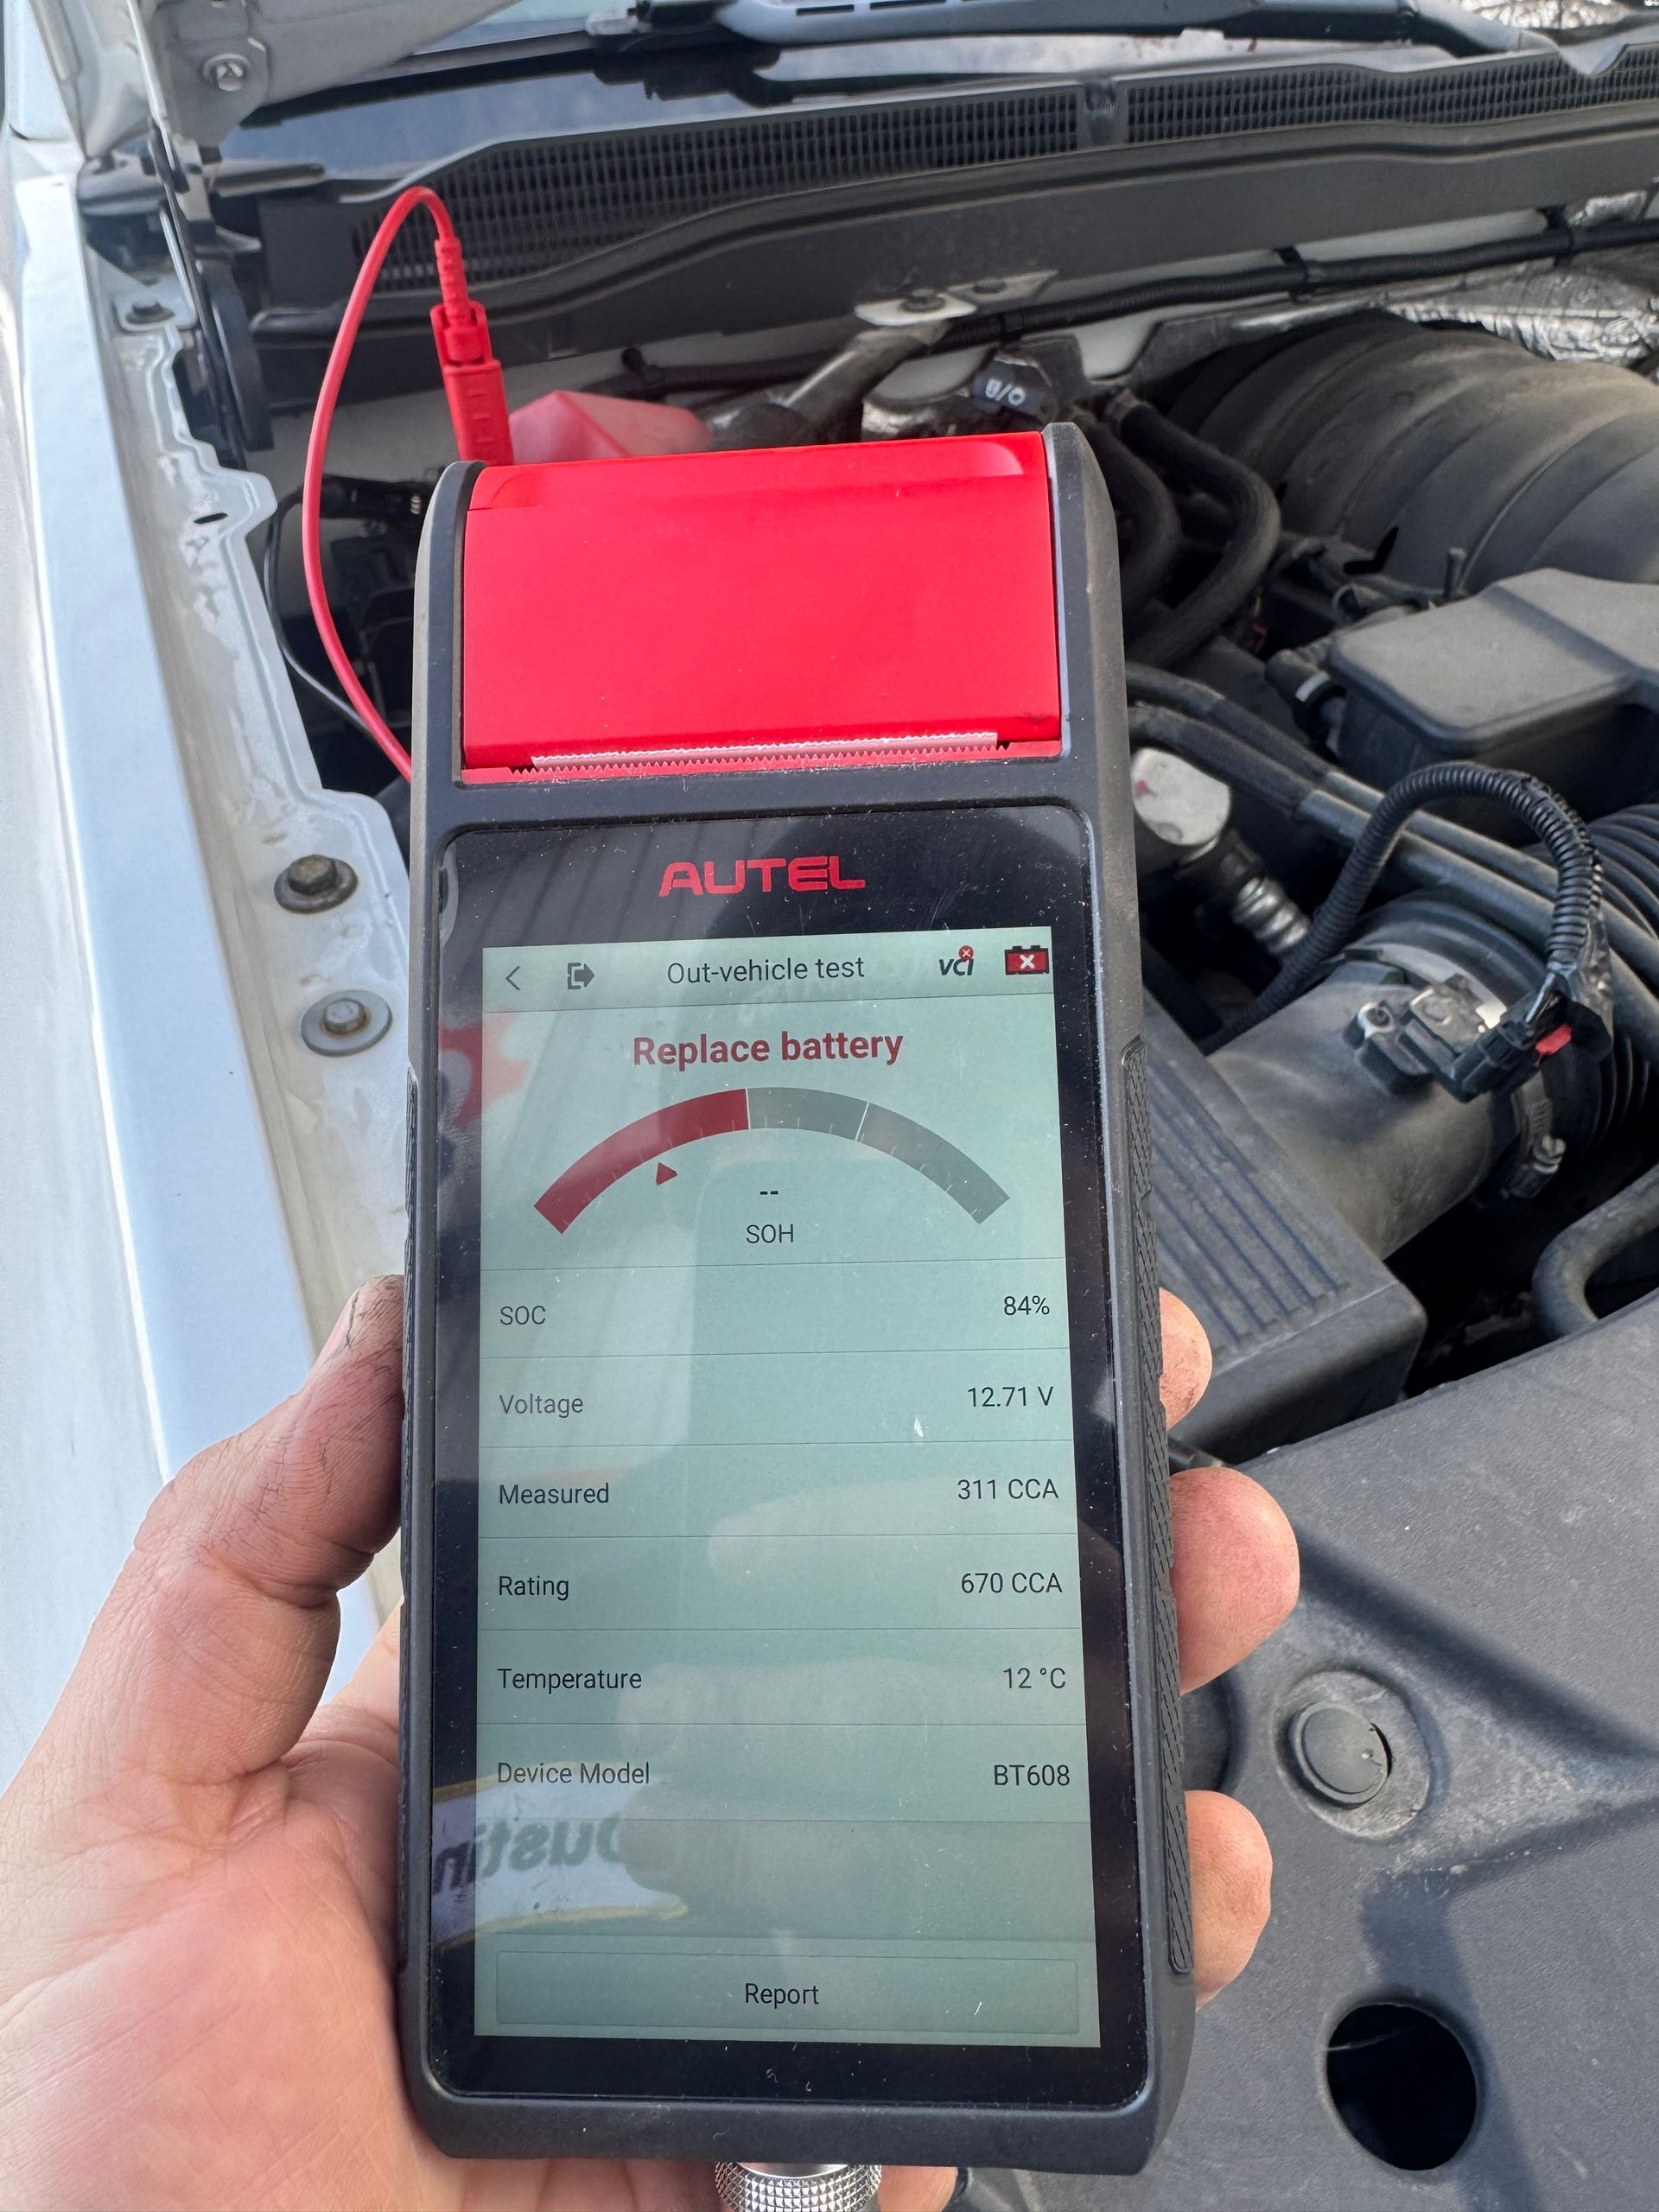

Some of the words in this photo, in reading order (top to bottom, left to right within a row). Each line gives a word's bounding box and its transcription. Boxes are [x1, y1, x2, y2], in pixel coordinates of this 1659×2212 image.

[659, 855, 866, 897] AUTEL
[667, 958, 808, 985] Out-vehicle
[816, 957, 865, 980] test
[633, 1033, 770, 1071] Replace
[781, 1031, 904, 1066] battery
[746, 1224, 794, 1244] SOH
[499, 1305, 547, 1326] SOC
[1002, 1294, 1051, 1318] 84%
[499, 1393, 584, 1419] Voltage
[967, 1386, 1028, 1408] 12.71
[1036, 1385, 1054, 1407] V
[499, 1482, 609, 1505] Measured
[956, 1478, 997, 1501] 311
[1007, 1478, 1059, 1501] CCA
[498, 1575, 569, 1602] Rating
[961, 1572, 1004, 1594] 670
[1011, 1571, 1064, 1594] CCA
[497, 1668, 643, 1694] Temperature
[1002, 1667, 1032, 1689] 12
[1039, 1667, 1066, 1689] °C
[497, 1761, 572, 1784] Device
[580, 1761, 651, 1784] Model
[993, 1764, 1072, 1787] BT608
[745, 1982, 820, 2010] Report
